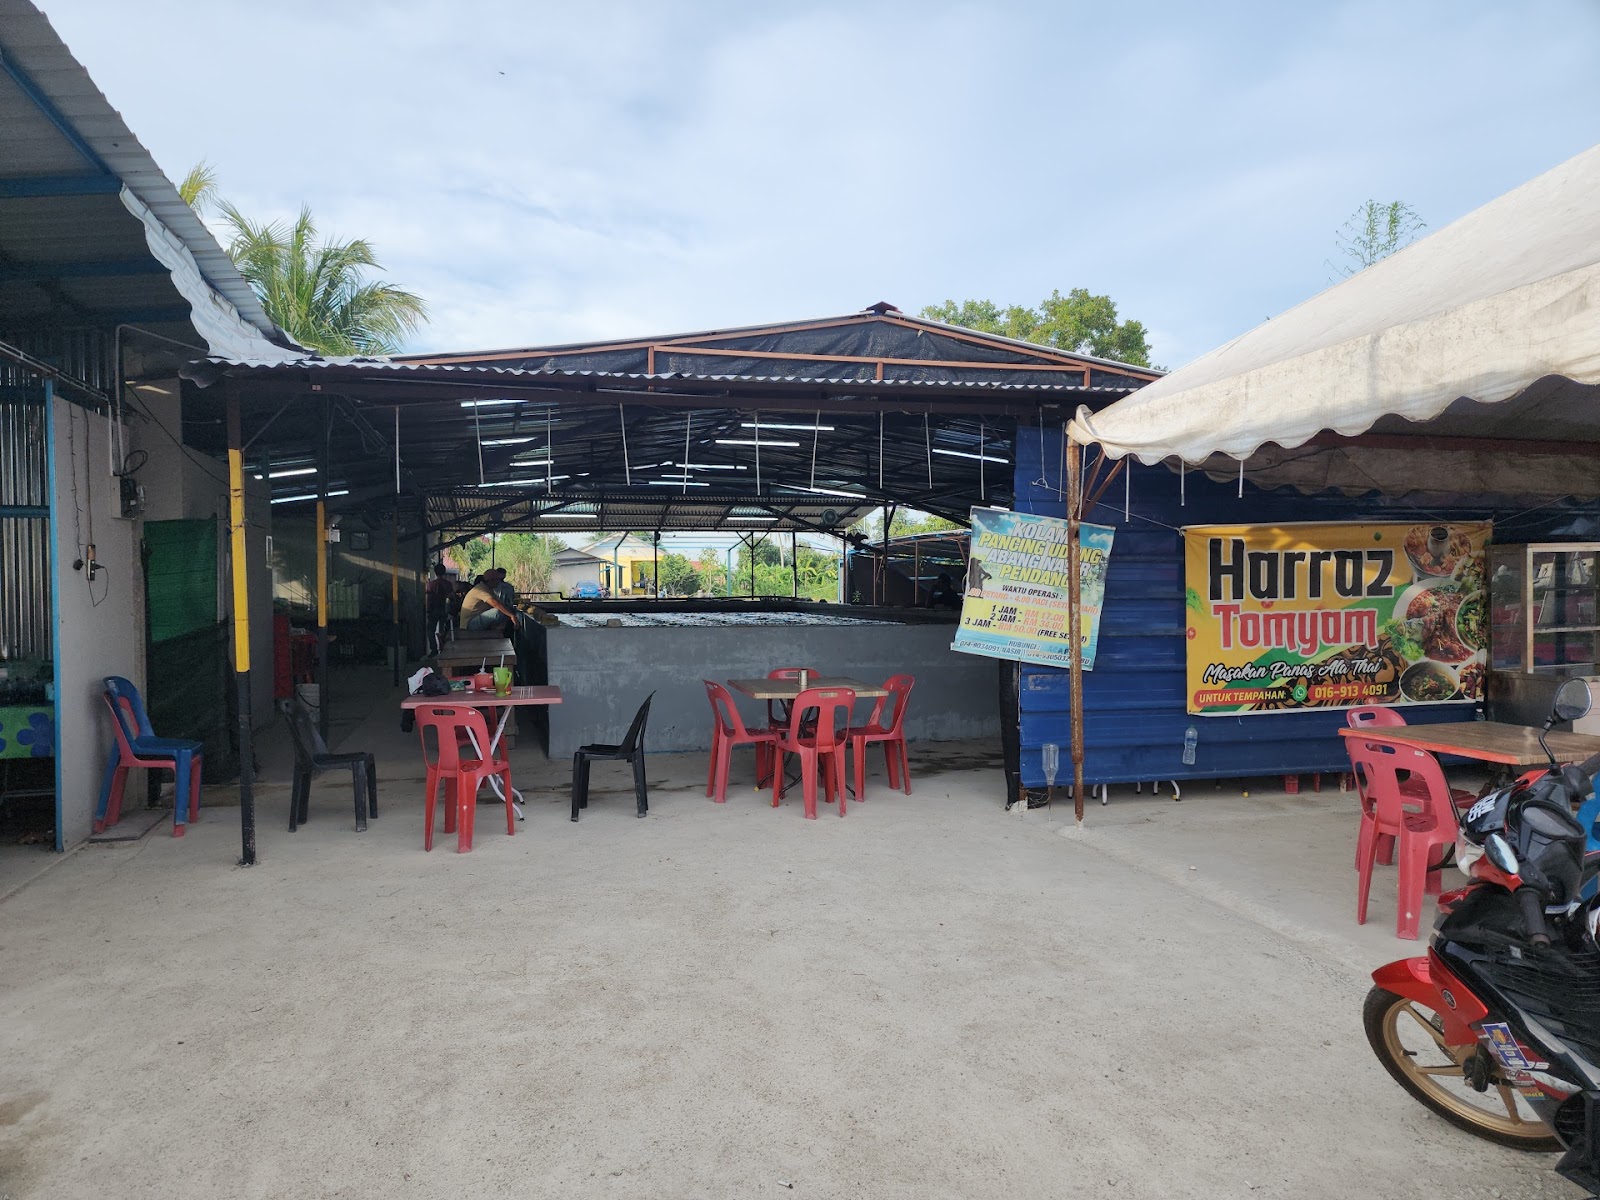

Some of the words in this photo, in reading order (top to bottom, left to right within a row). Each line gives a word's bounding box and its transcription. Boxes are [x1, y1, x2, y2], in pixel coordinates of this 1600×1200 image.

[1011, 521, 1068, 545] KOLAM
[978, 532, 1046, 557] PANCING
[1048, 542, 1103, 566] UDNG
[986, 549, 1041, 569] ABANG
[1043, 556, 1092, 577] NAR
[1209, 537, 1394, 601] Harraz
[999, 565, 1069, 589] PENDANG
[981, 590, 1009, 600] PETANG
[1031, 598, 1048, 606] PAGI
[1002, 584, 1027, 595] WAKTU
[997, 614, 1016, 623] JAM
[1023, 617, 1037, 626] RM
[1039, 620, 1063, 630] 34.00
[998, 606, 1017, 615] JAM
[1024, 609, 1038, 618] RM
[1041, 612, 1065, 622] 17.00
[972, 619, 991, 628] JAM
[998, 622, 1012, 630] RM
[1014, 625, 1037, 635] 50.00
[1213, 604, 1379, 657] Tomyam
[1203, 662, 1267, 684] Masakan
[1270, 661, 1317, 680] Panas
[1318, 661, 1349, 678] Ala
[1350, 659, 1381, 676] Thai
[1198, 692, 1231, 704] UNTUK
[1314, 685, 1359, 699] 016-913
[1361, 683, 1388, 697] 4091
